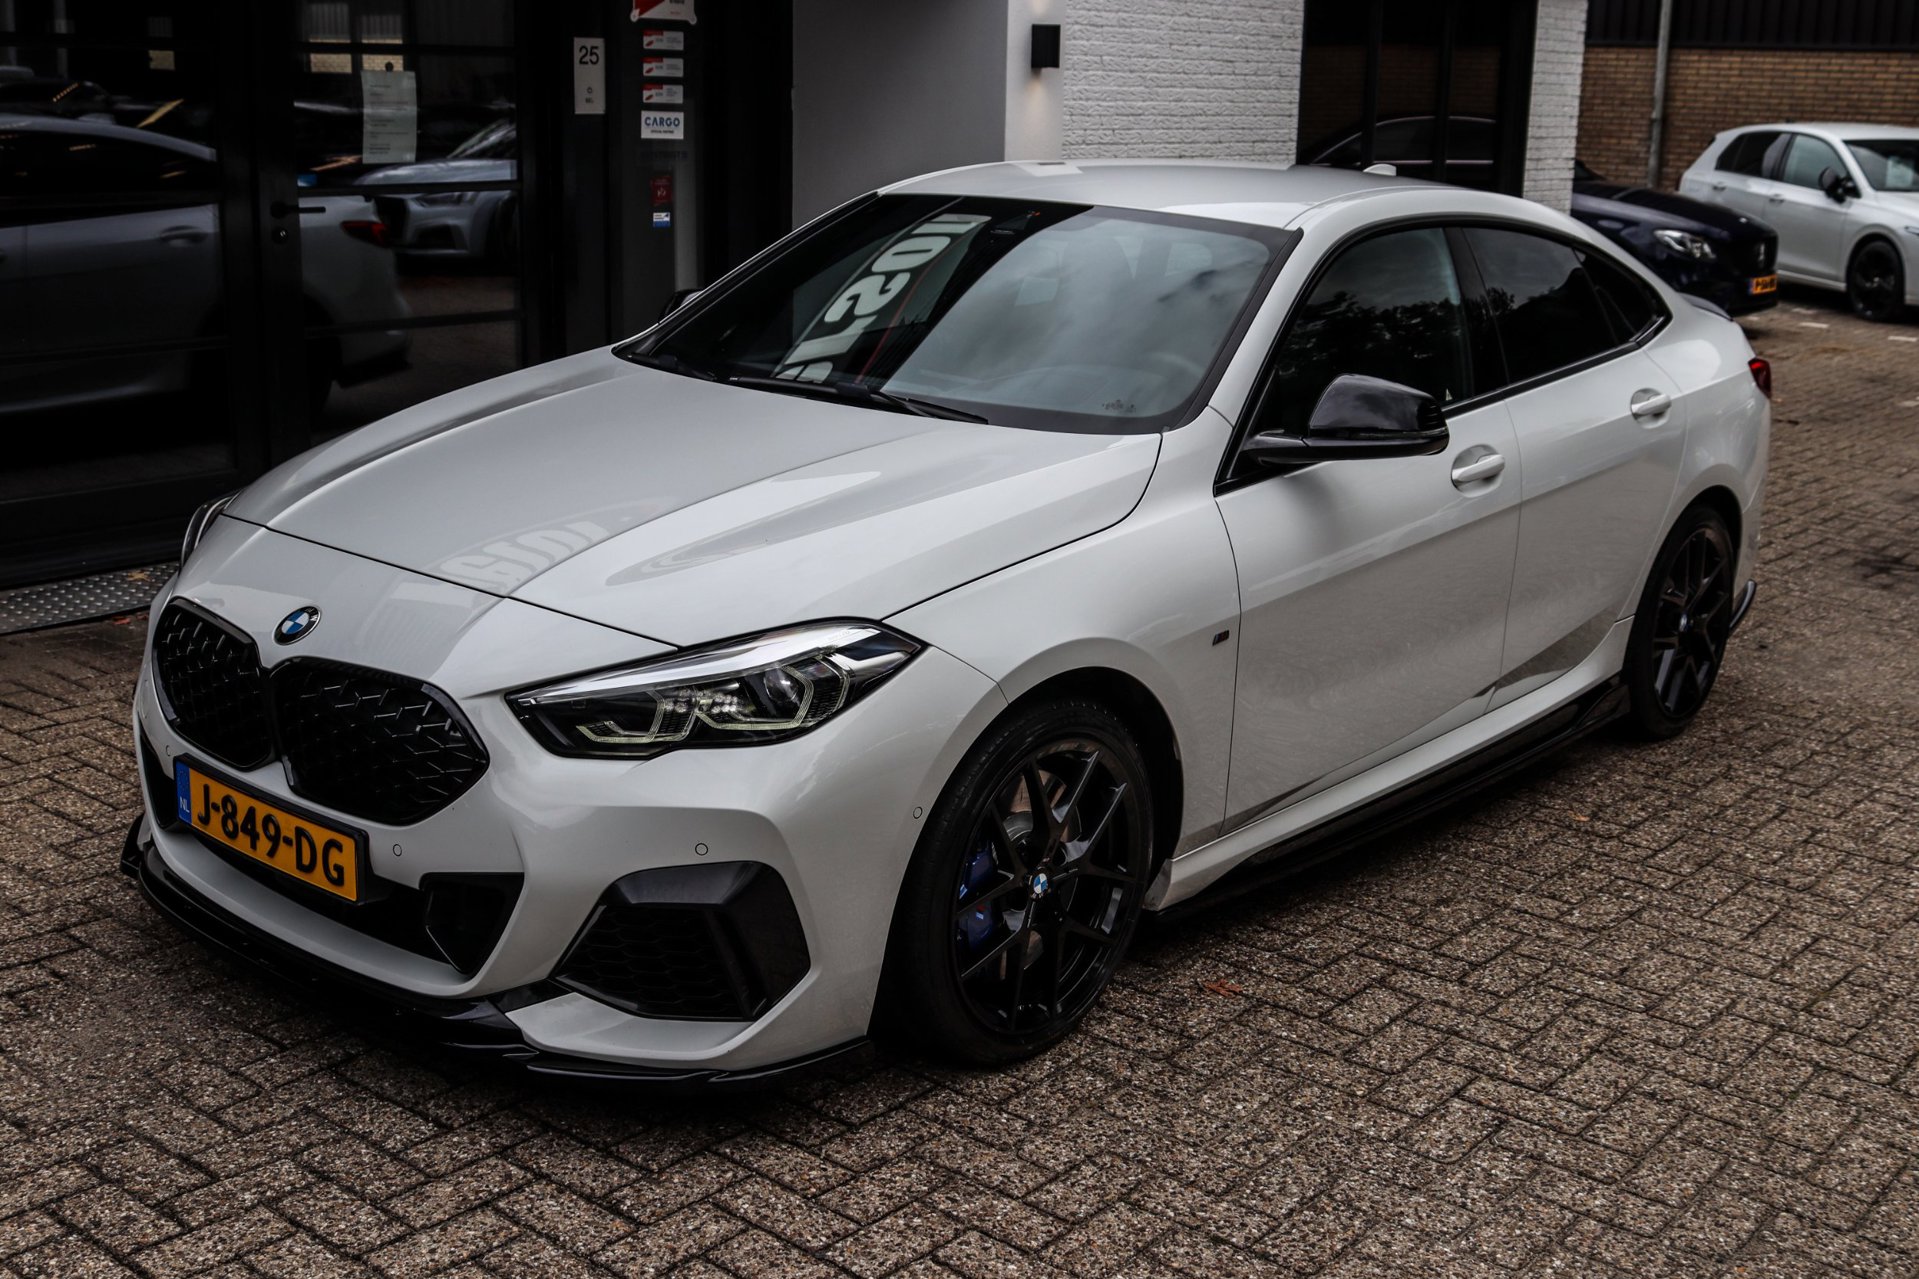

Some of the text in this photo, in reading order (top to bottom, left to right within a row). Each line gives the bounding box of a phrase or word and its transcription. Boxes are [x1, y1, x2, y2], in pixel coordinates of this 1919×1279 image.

[578, 45, 600, 65] 25
[644, 116, 680, 127] CARGO
[179, 796, 190, 813] NL
[197, 783, 345, 887] J-849-DG
